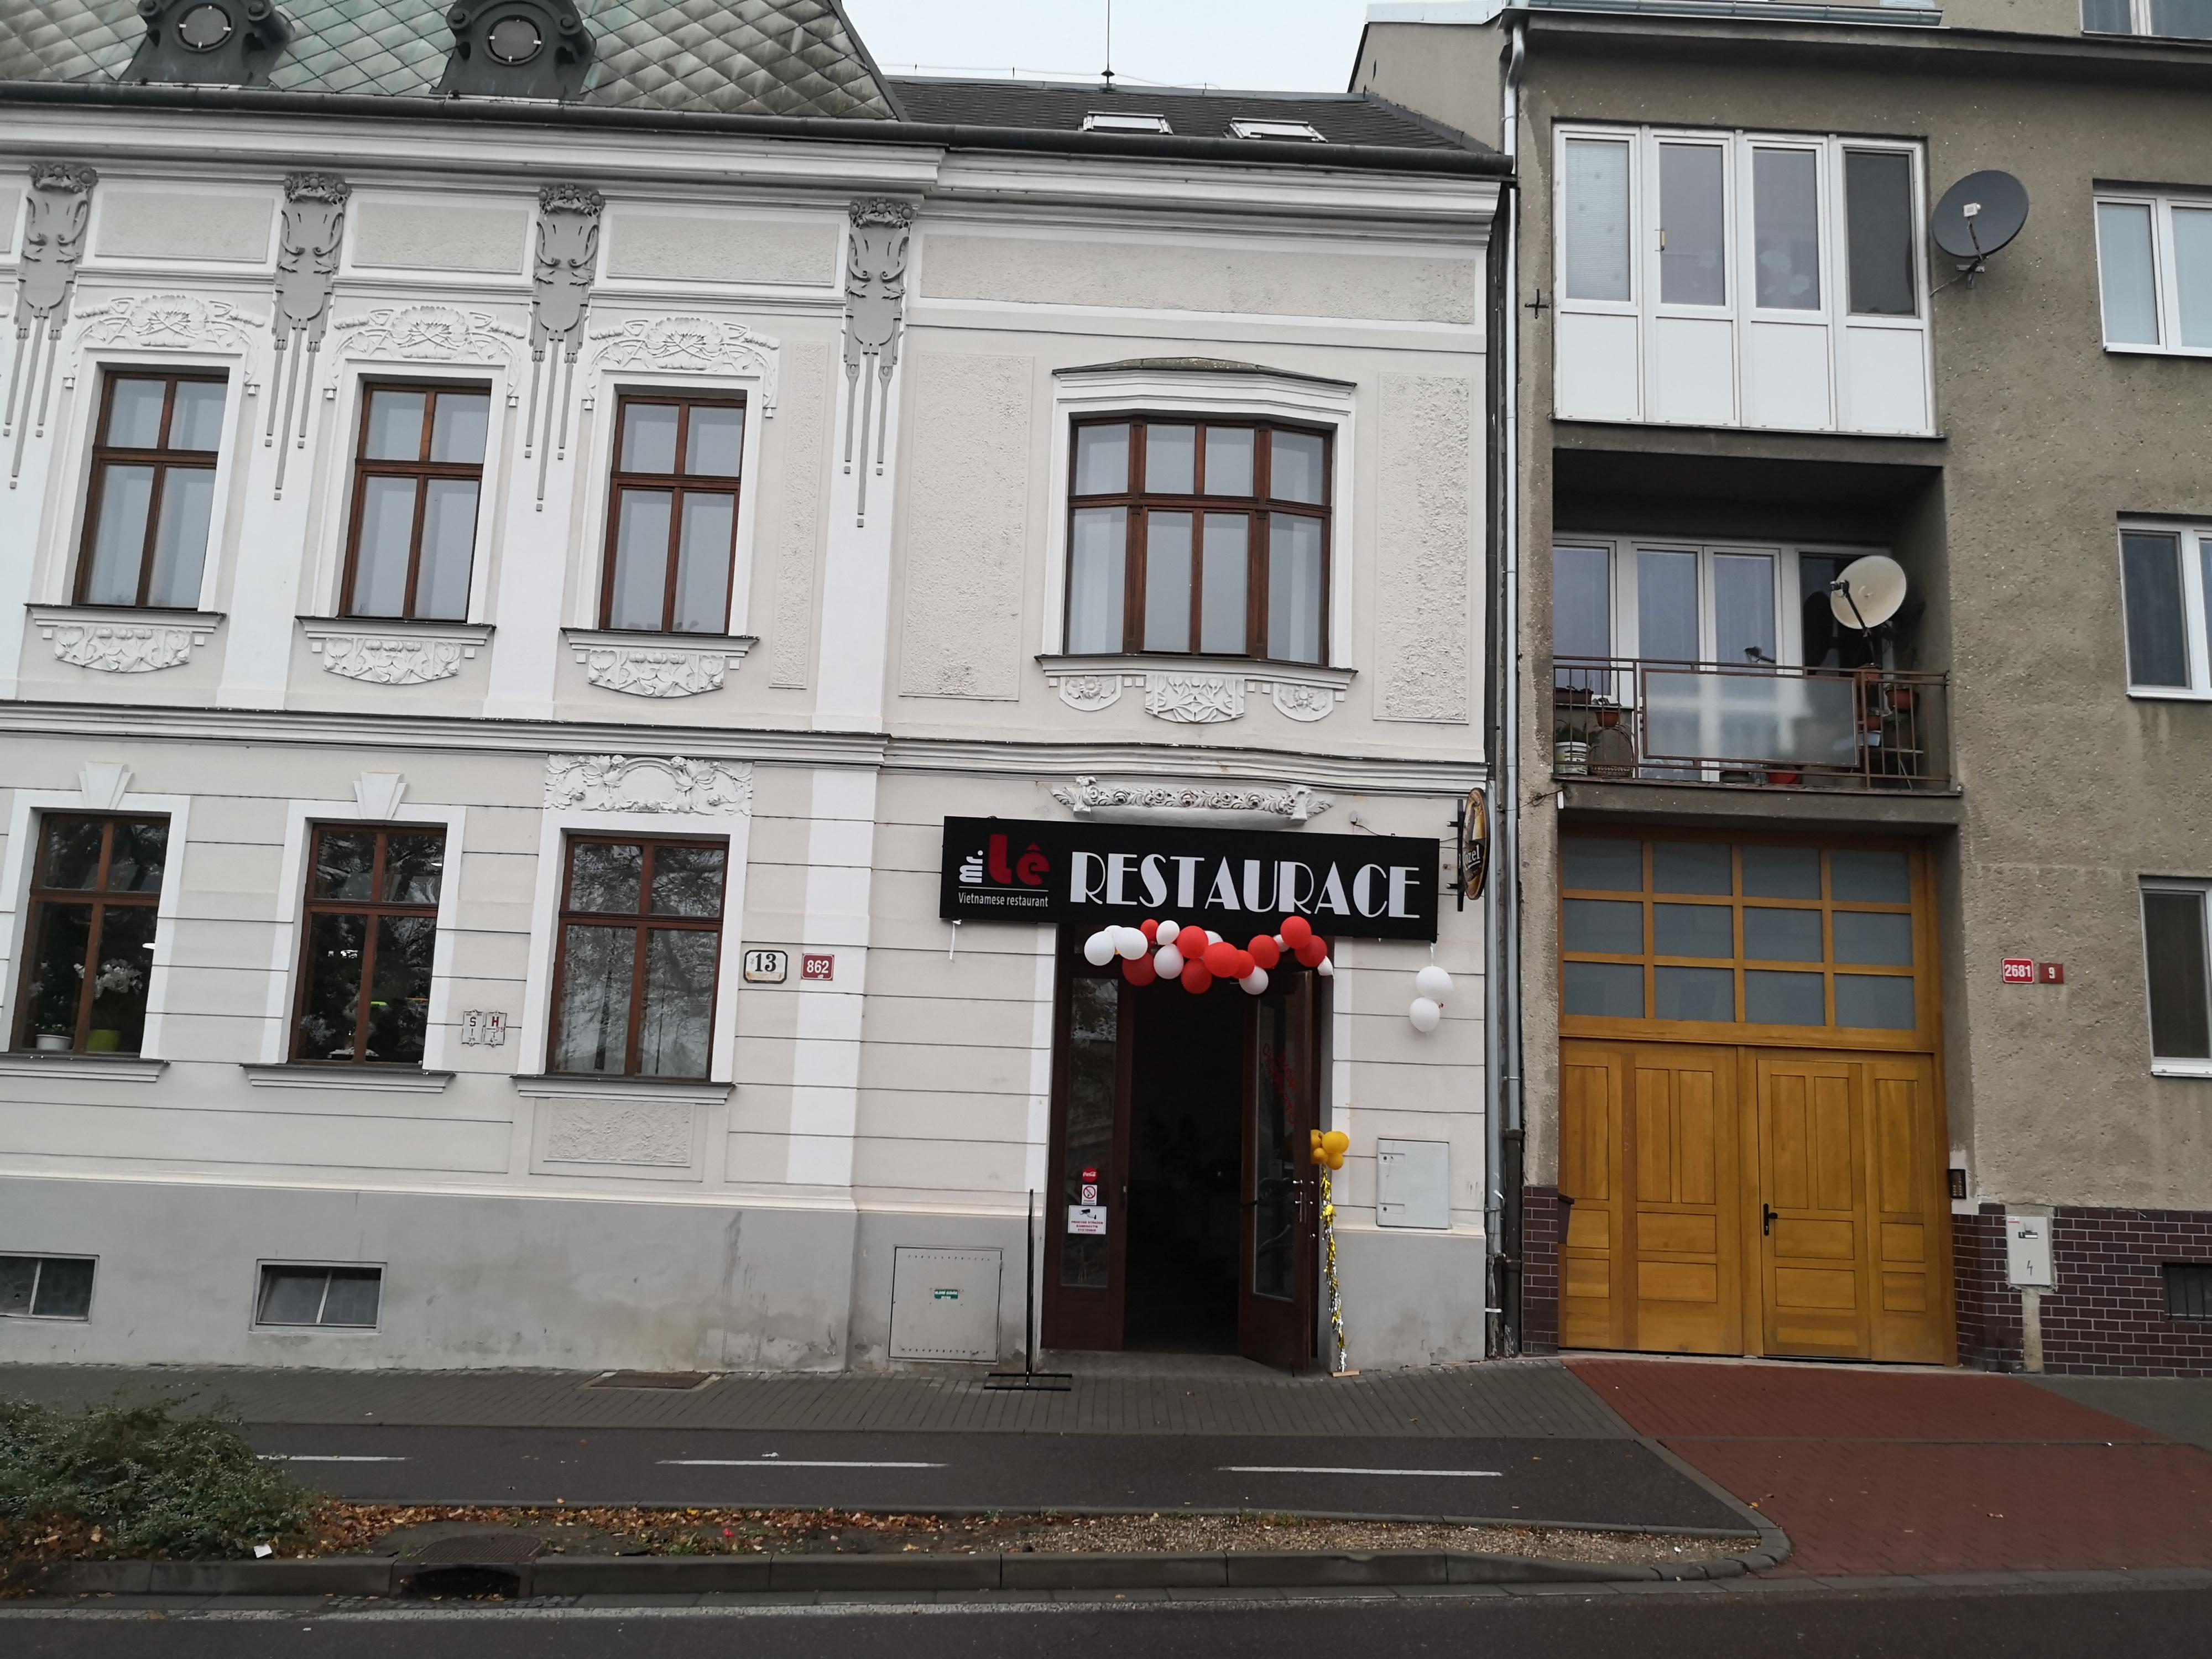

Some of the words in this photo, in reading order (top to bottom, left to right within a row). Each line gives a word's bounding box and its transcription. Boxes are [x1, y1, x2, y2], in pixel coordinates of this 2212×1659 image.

[959, 850, 983, 883] mr.
[1070, 852, 1421, 919] RESTAURACE
[958, 892, 1005, 905] Vietnamese
[1006, 895, 1048, 907] restaurant
[755, 953, 776, 972] 13
[806, 959, 829, 973] 862
[2005, 964, 2031, 977] 2681
[2048, 967, 2056, 979] 9
[469, 1017, 476, 1027] S
[491, 1016, 499, 1027] H
